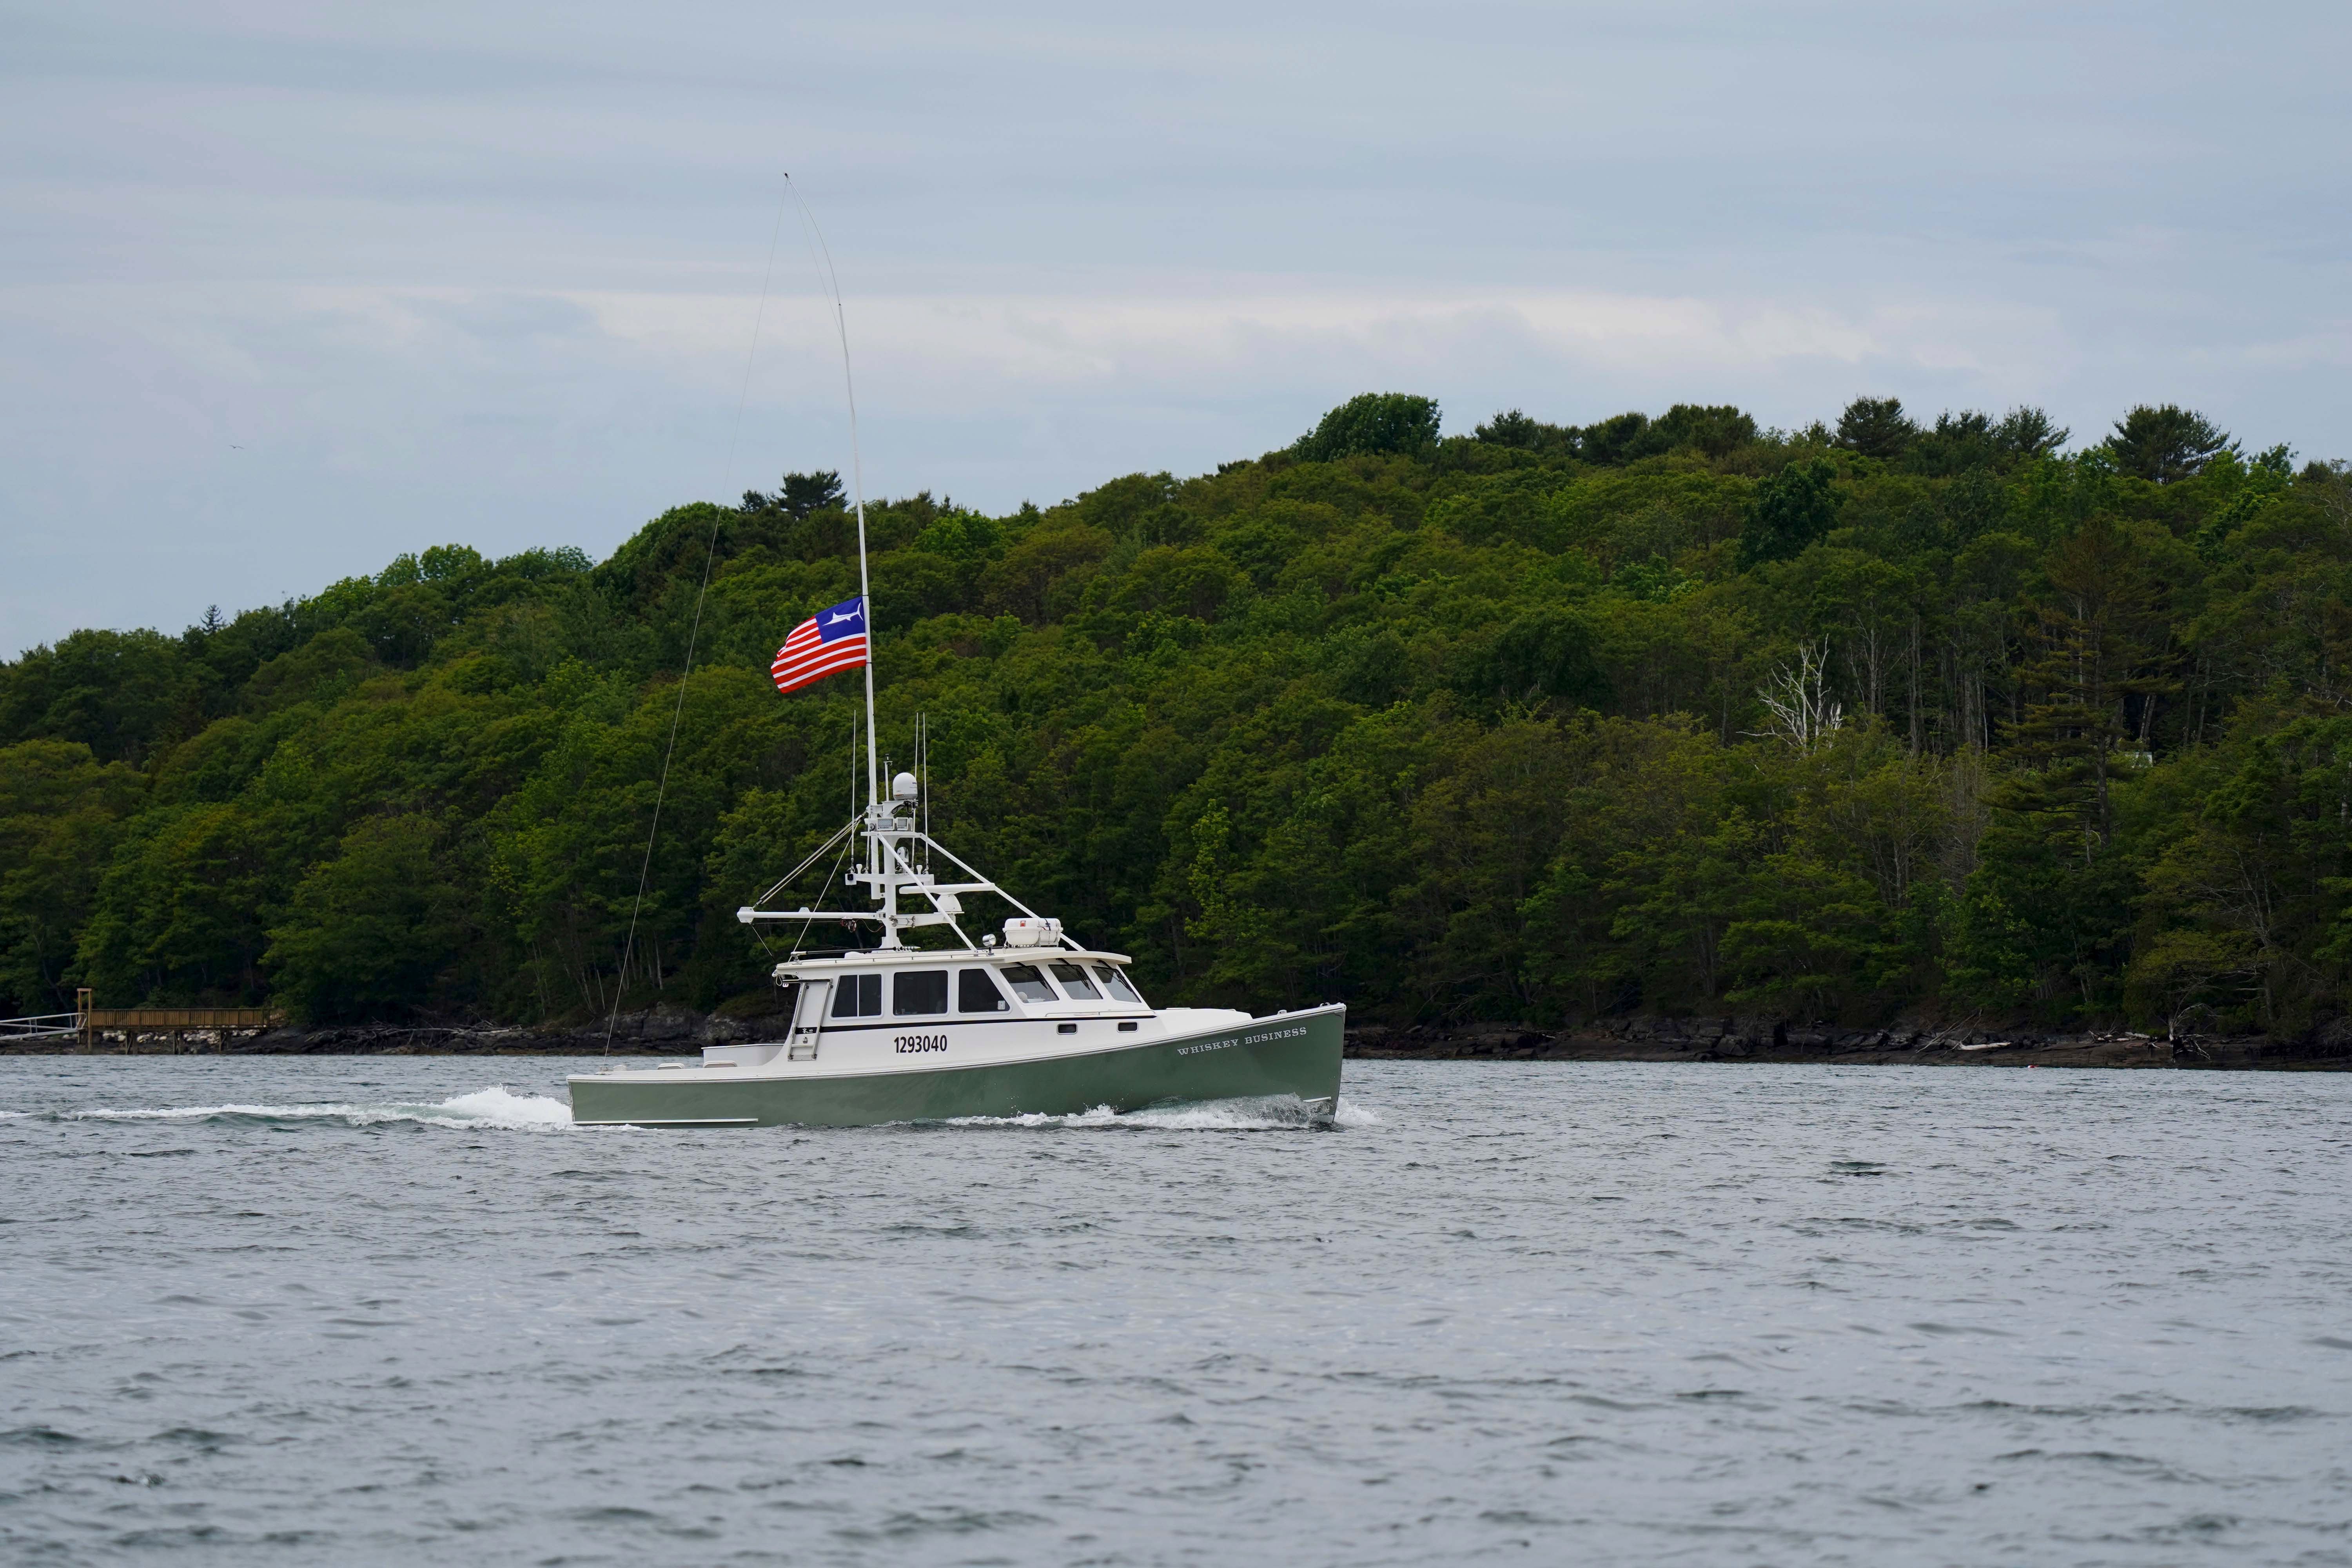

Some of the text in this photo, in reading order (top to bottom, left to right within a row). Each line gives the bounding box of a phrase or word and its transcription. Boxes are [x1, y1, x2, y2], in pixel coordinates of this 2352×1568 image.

[894, 1034, 947, 1053] 1293040
[1177, 1027, 1307, 1055] WHISKEY BUSINESS
